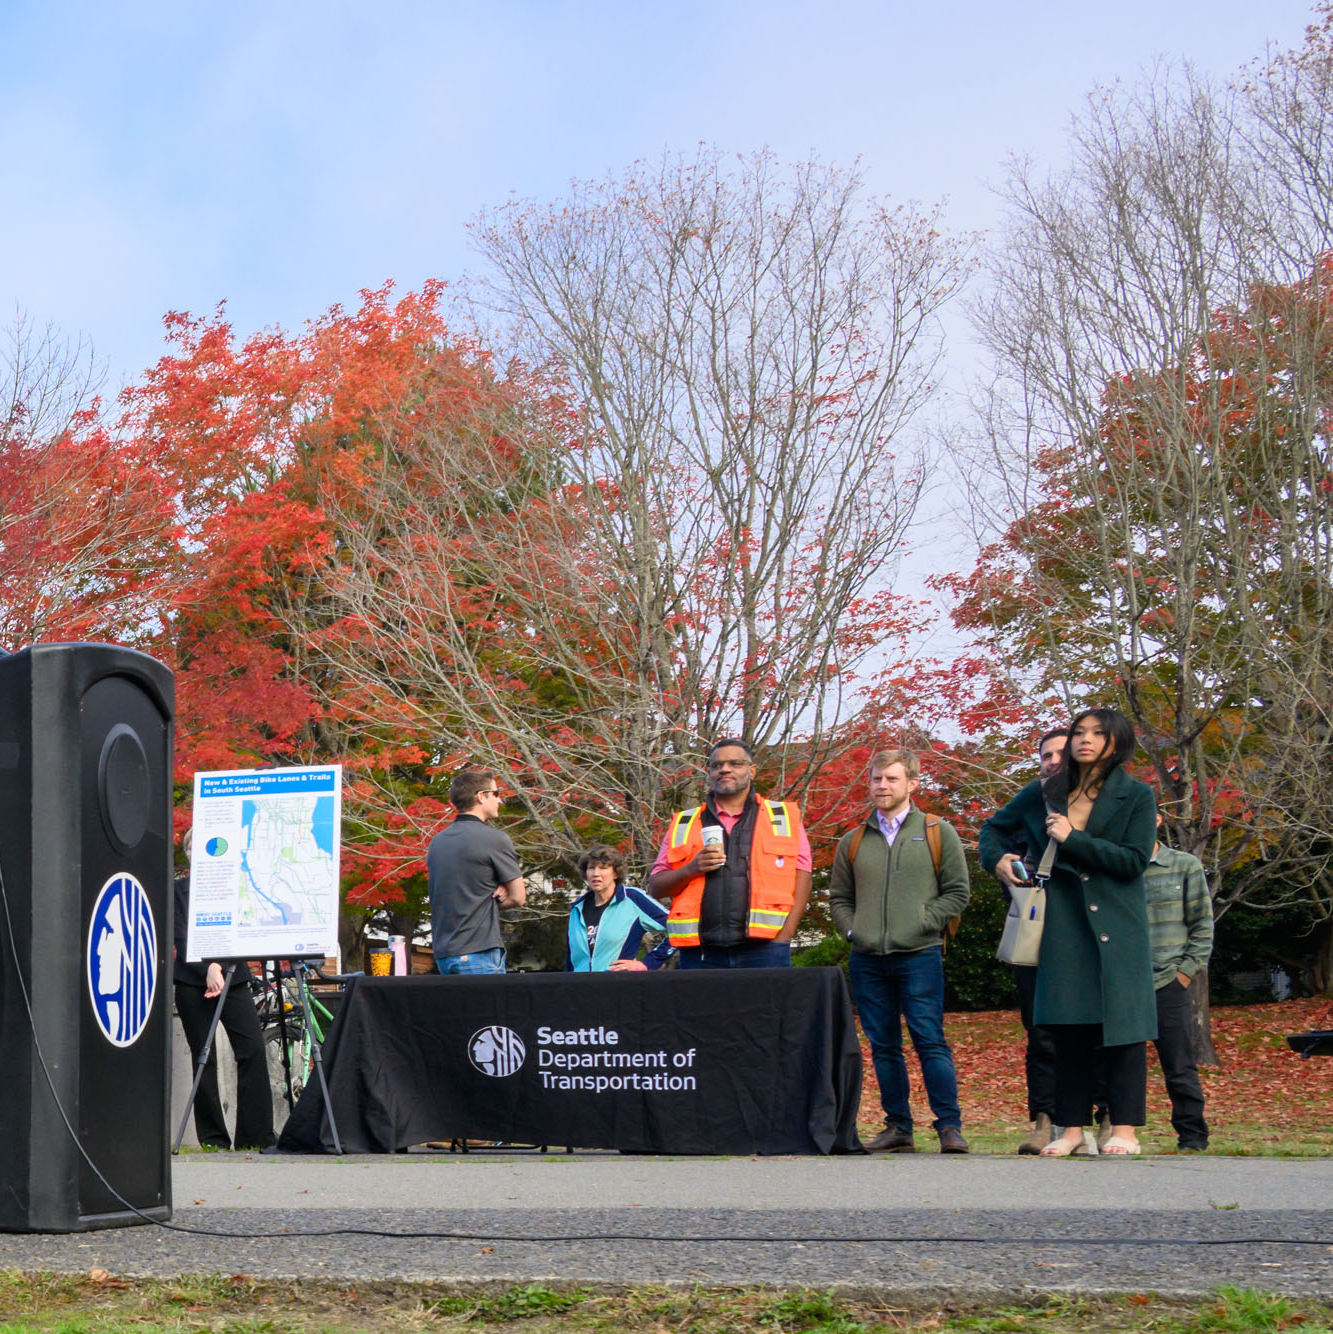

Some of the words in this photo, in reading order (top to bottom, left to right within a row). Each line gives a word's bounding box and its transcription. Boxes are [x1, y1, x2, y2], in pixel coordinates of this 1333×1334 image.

[229, 777, 258, 785] Existing
[234, 785, 261, 793] Seattle
[536, 1026, 619, 1045] Seattle
[538, 1049, 667, 1071] Department
[672, 1048, 696, 1068] of
[539, 1071, 697, 1093] Transportation
